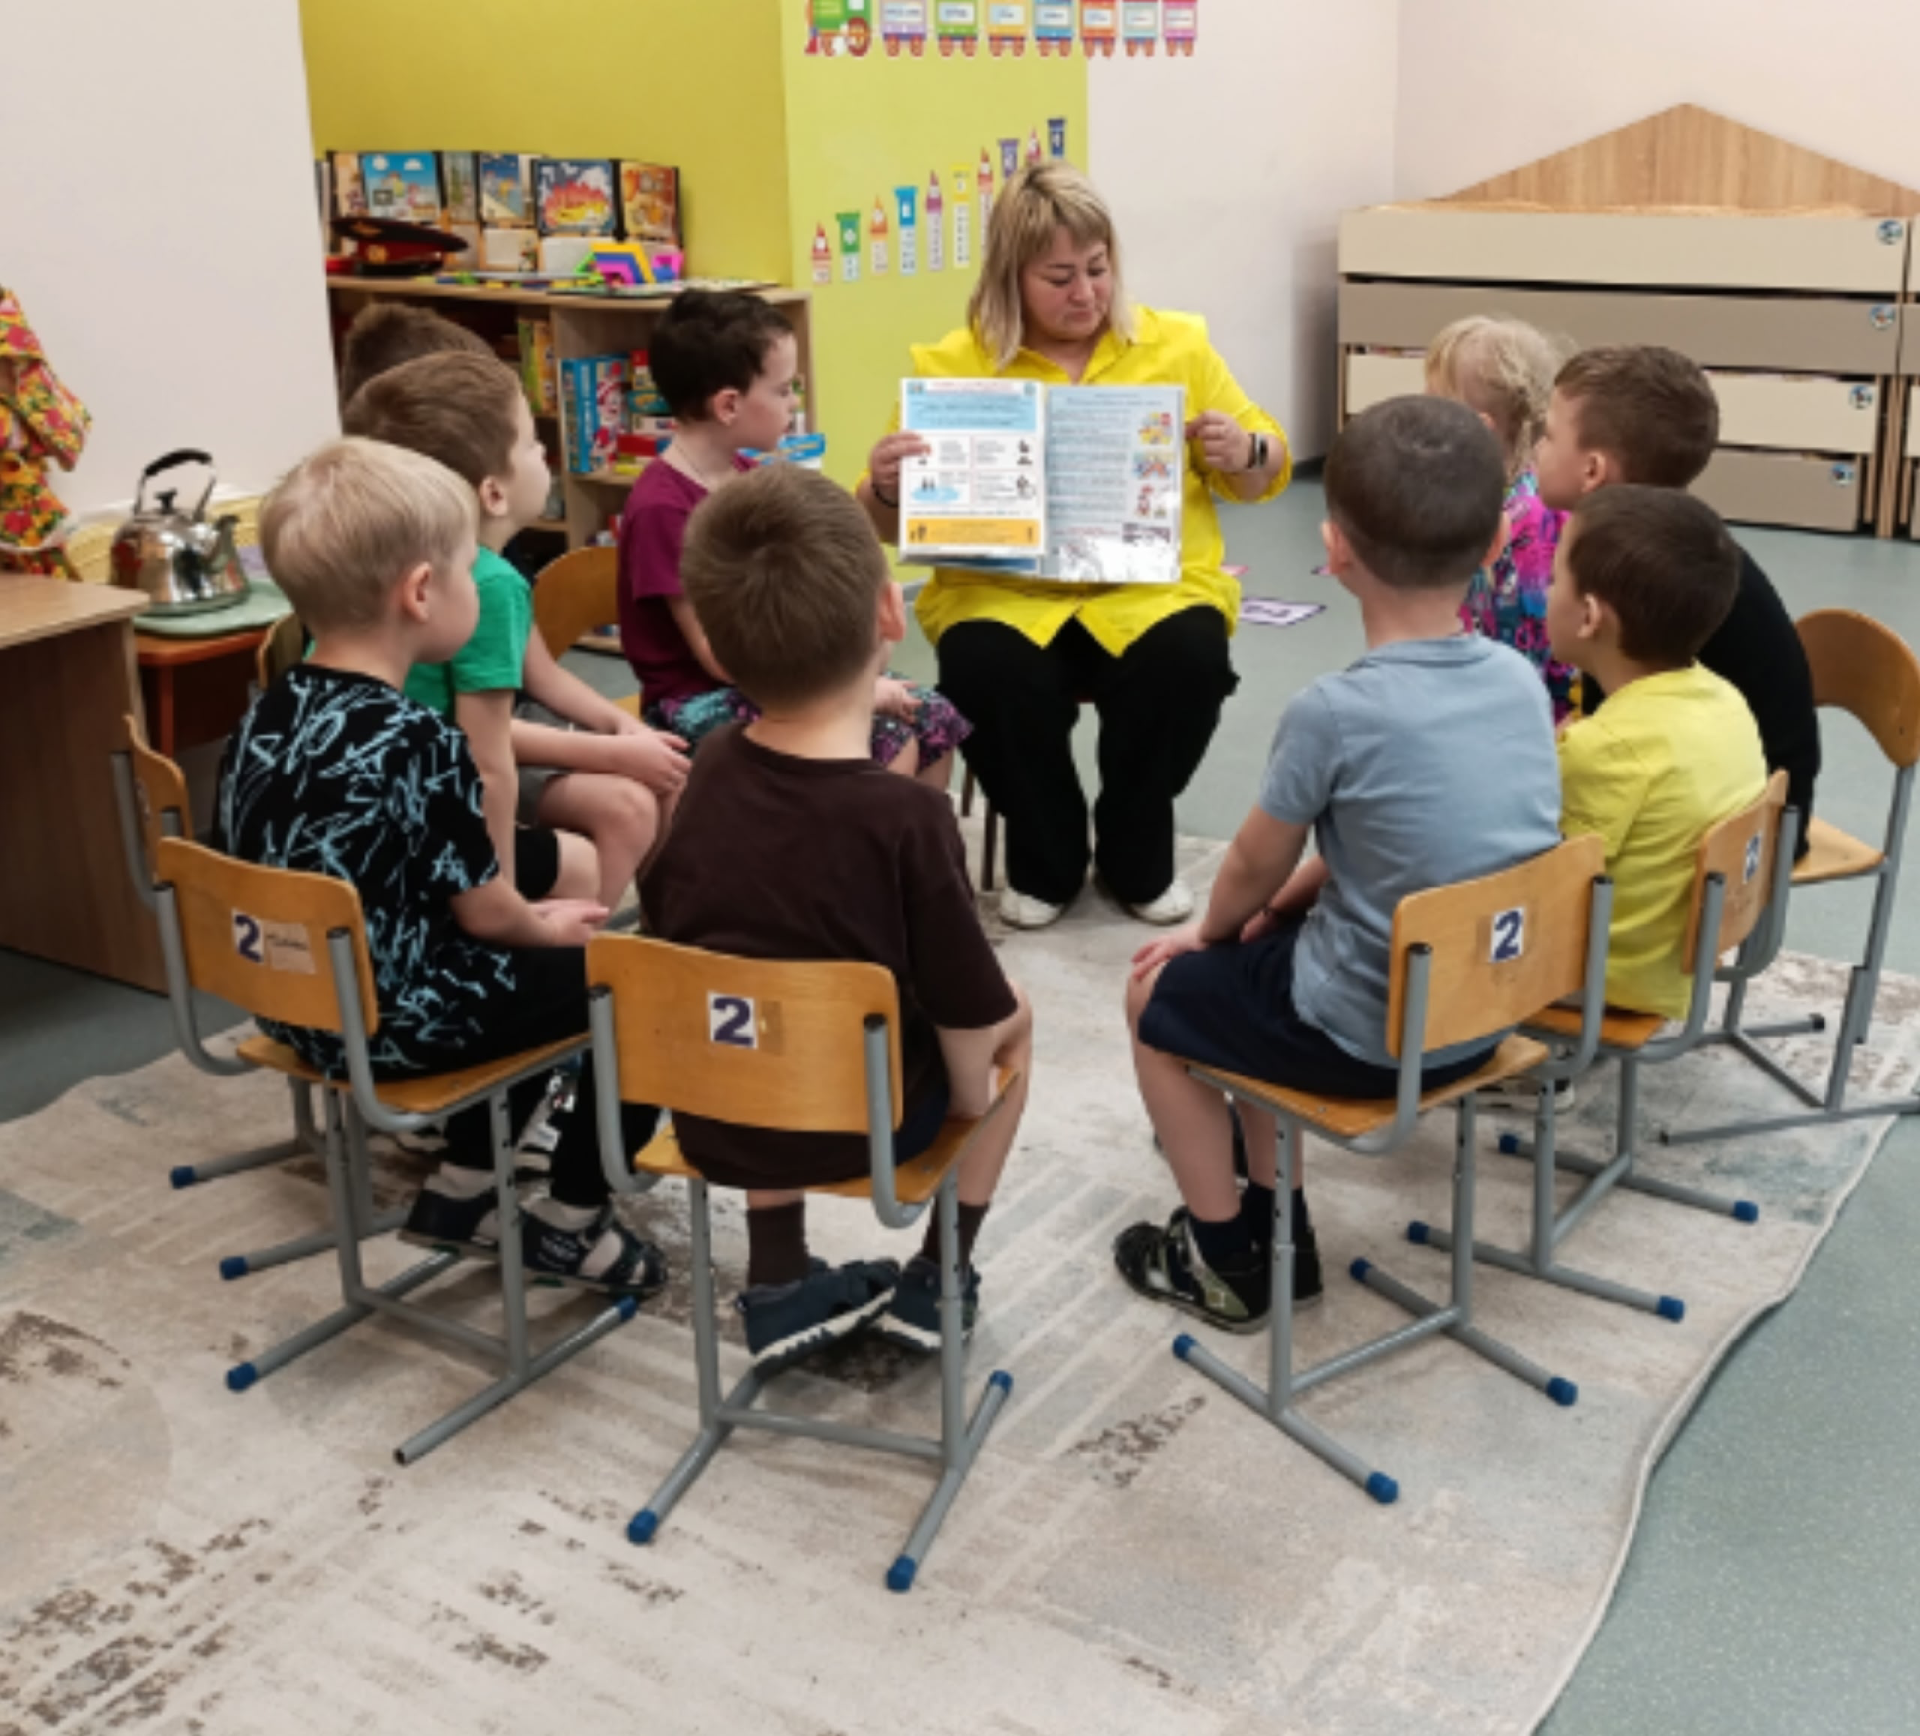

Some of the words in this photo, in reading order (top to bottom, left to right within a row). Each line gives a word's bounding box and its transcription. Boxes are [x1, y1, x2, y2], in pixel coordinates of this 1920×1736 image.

[235, 914, 262, 963] 2
[1493, 910, 1522, 961] 2
[713, 997, 754, 1046] 2
